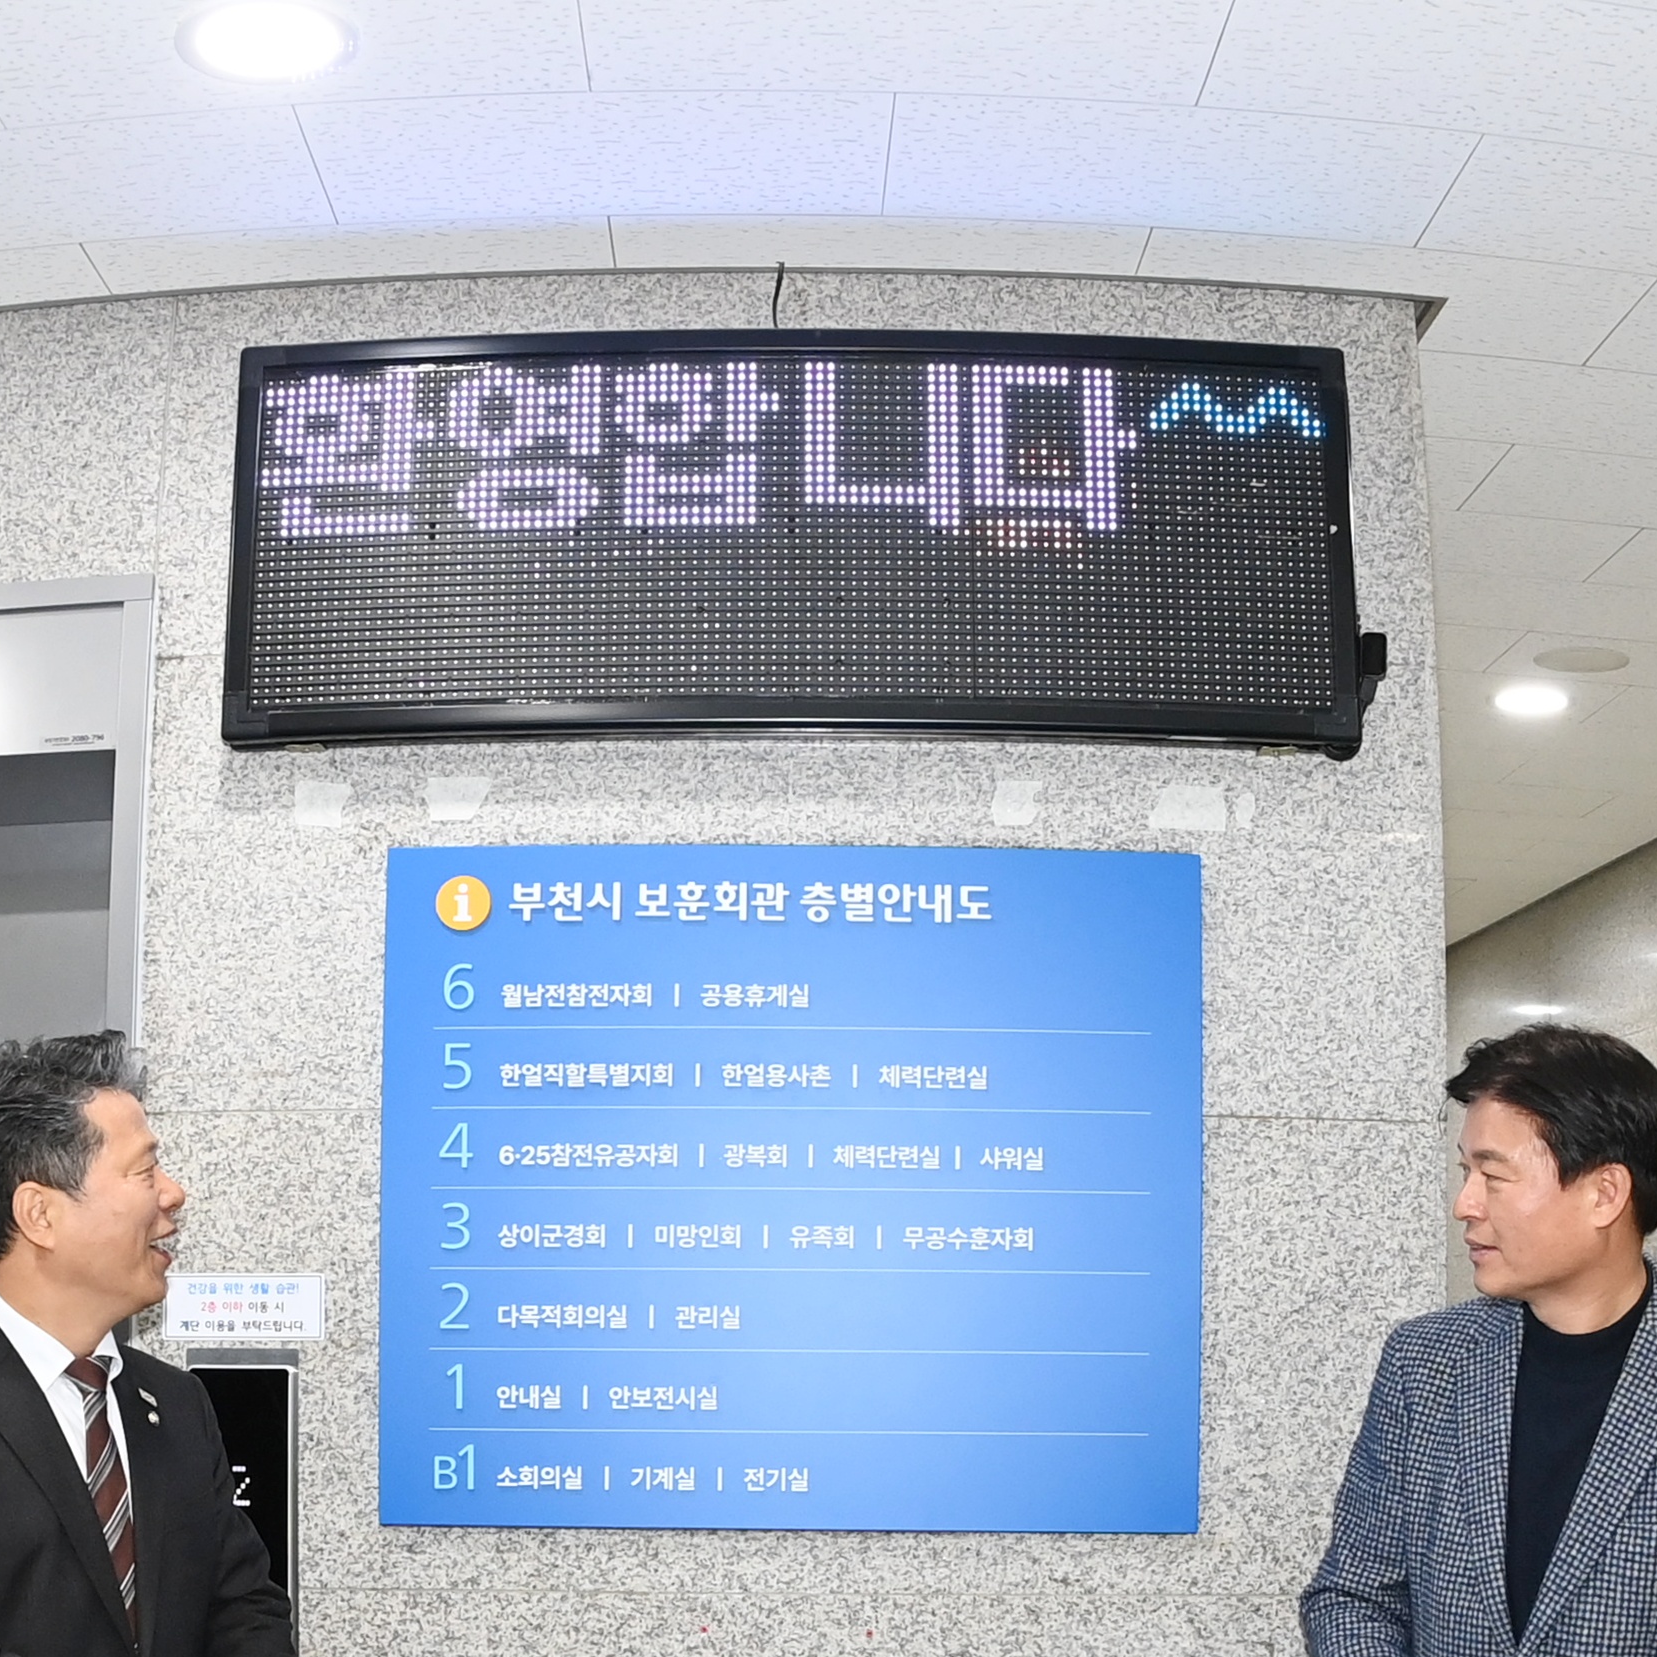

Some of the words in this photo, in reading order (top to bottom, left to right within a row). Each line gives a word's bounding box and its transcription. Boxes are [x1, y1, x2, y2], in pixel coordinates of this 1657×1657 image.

[261, 362, 1139, 536] 환영합니다
[508, 881, 621, 922] 부천시
[635, 880, 790, 921] 보훈회관
[799, 881, 992, 923] 층별안내도
[443, 963, 475, 1010] 6
[501, 983, 652, 1008] 월남전참전자회
[700, 983, 809, 1008] 공용휴게실
[443, 1042, 472, 1089] 5
[500, 1063, 673, 1087] 한얼직할특별지회
[722, 1063, 832, 1088] 한얼용사촌
[879, 1064, 987, 1090] 체력단련실
[438, 1122, 474, 1168] 4
[499, 1143, 678, 1167] 6·25참전유공자회
[724, 1143, 787, 1168] 광복회
[833, 1144, 940, 1169] 체력단련실
[980, 1146, 1044, 1171] 샤워실
[440, 1202, 470, 1249] 3
[498, 1223, 606, 1248] 상이군경회
[655, 1224, 741, 1249] 미망인회
[789, 1225, 854, 1249] 유족회
[902, 1226, 1033, 1251] 무공수훈자회
[187, 1282, 218, 1295] 건강을
[223, 1282, 243, 1295] 위한
[250, 1282, 269, 1295] 생활
[276, 1282, 299, 1295] 습관!
[201, 1301, 217, 1313] 2층
[222, 1301, 243, 1313] 이하
[248, 1301, 269, 1313] 이동
[274, 1301, 285, 1313] 시
[439, 1282, 470, 1329] 2
[498, 1304, 628, 1329] 다목적회의실
[675, 1305, 740, 1330] 관리실
[179, 1320, 200, 1332] 계단
[205, 1320, 236, 1332] 이용을
[446, 1363, 463, 1409] 1
[496, 1384, 561, 1409] 안내실
[609, 1385, 718, 1411] 안보전시실
[434, 1443, 475, 1490] B1
[496, 1465, 583, 1490] 소회의실
[631, 1466, 695, 1491] 기계실
[743, 1467, 809, 1492] 전기실
